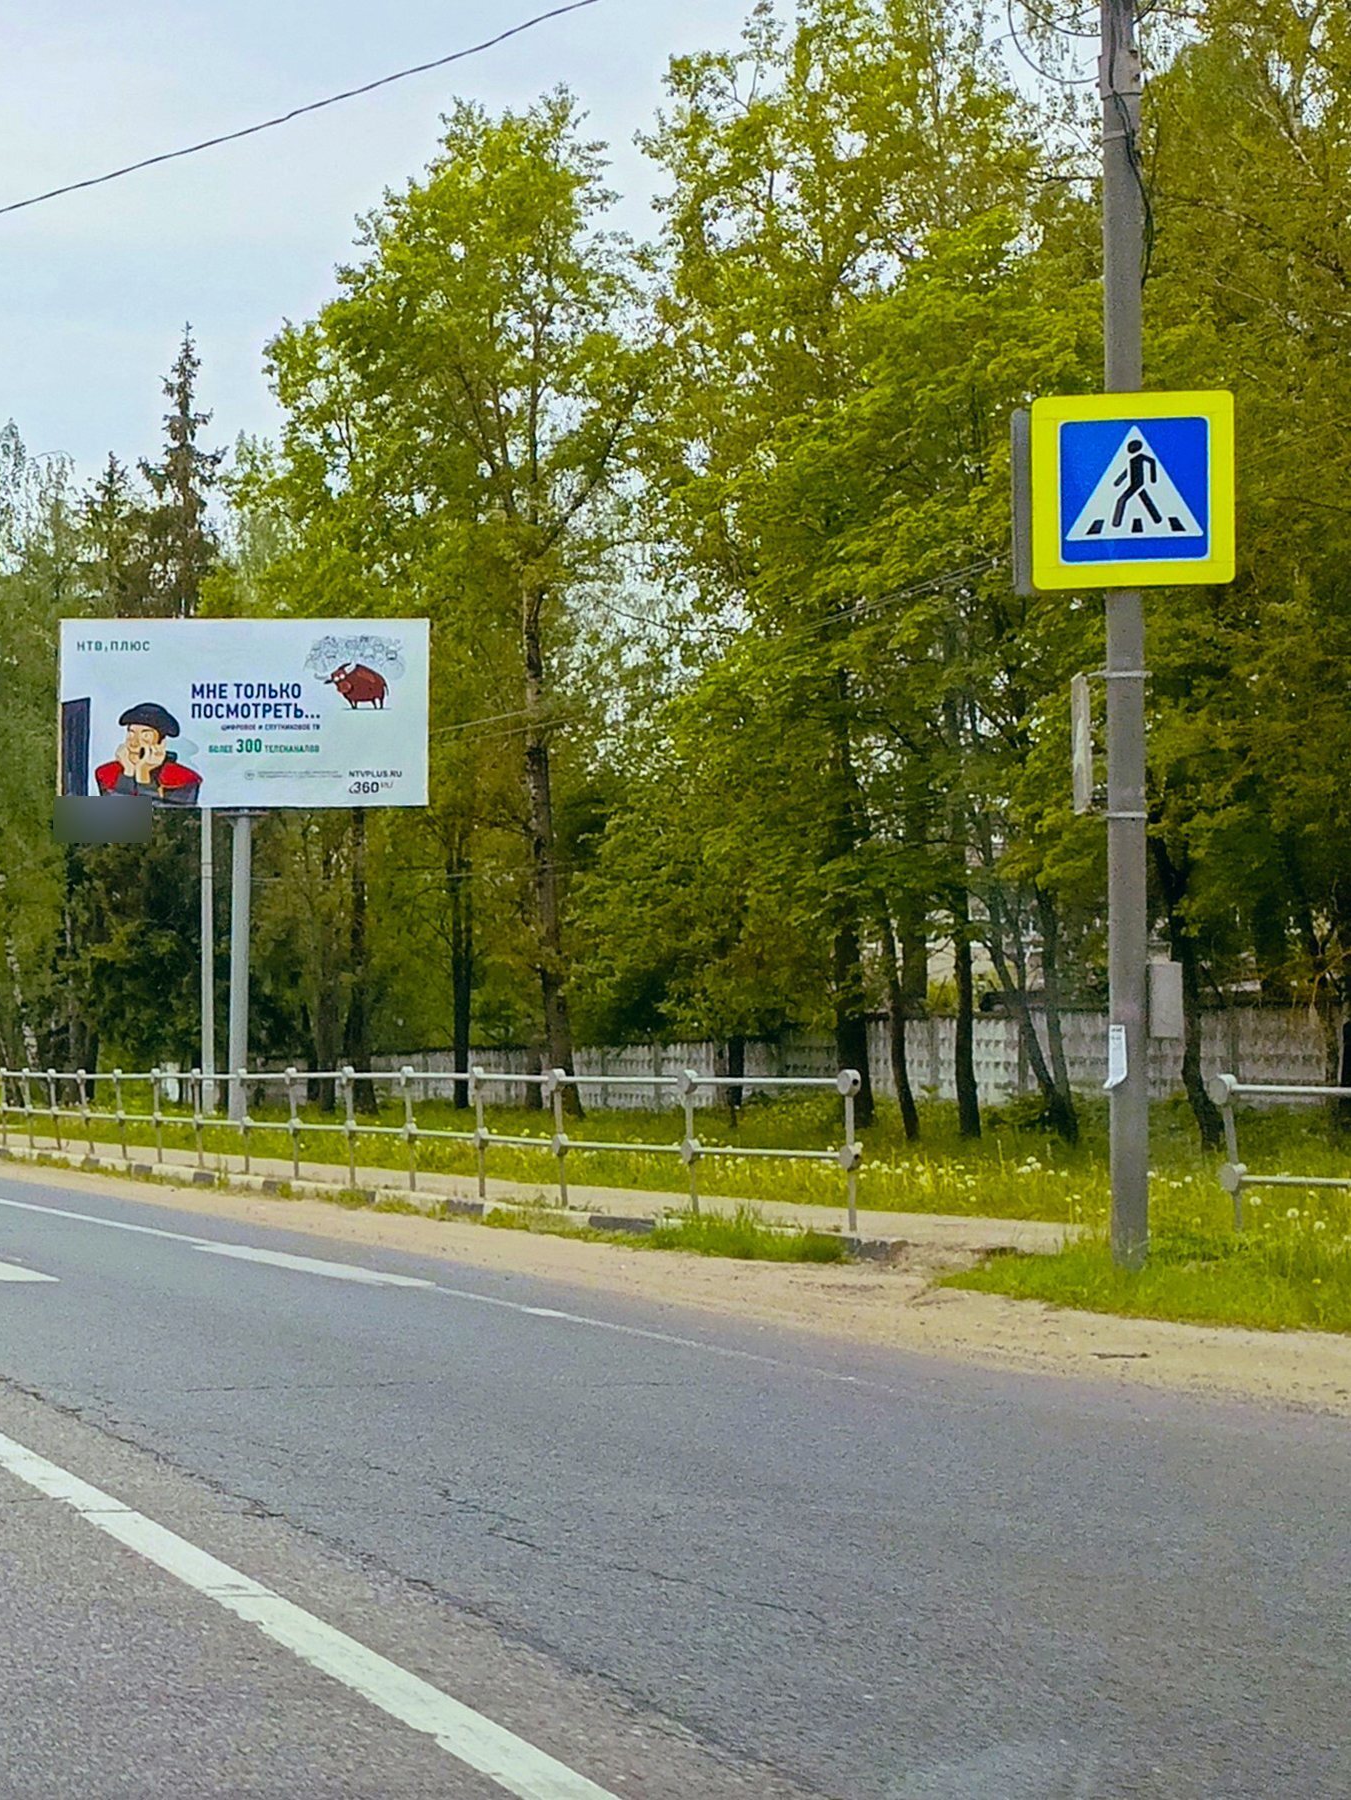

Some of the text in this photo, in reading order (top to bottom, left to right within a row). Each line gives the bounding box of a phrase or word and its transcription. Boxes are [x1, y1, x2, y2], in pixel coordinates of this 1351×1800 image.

[191, 683, 302, 699] МНЕ ТОЛЬКО
[191, 703, 321, 719] ПОСМОТРЕТЬ...
[208, 739, 320, 753] БОЛЕЕ 300 ТЕЛЕКАНАЛОВ
